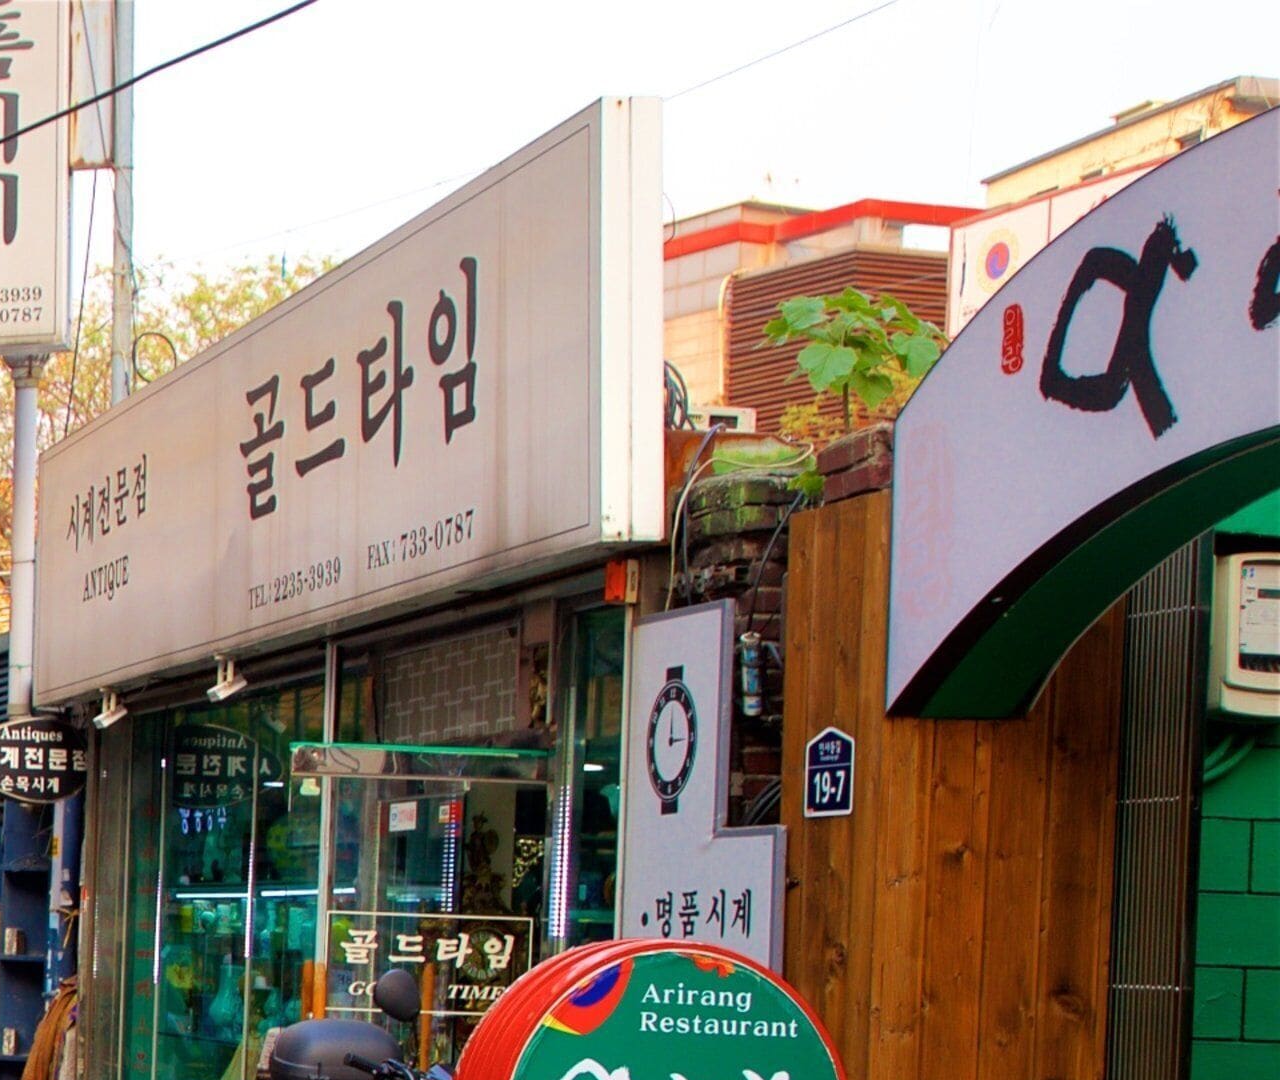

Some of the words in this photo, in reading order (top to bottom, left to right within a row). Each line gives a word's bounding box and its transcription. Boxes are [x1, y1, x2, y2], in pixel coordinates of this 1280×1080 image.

[240, 256, 478, 521] 골드타임
[66, 453, 147, 552] 시계전문점
[83, 556, 129, 603] ANTIQUE
[0, 726, 63, 743] Antiques
[814, 770, 845, 803] 19-7
[656, 888, 753, 939] 명품시계
[340, 929, 515, 969] 골드타임
[642, 983, 752, 1012] Arirang
[640, 1011, 798, 1038] Restaurant
